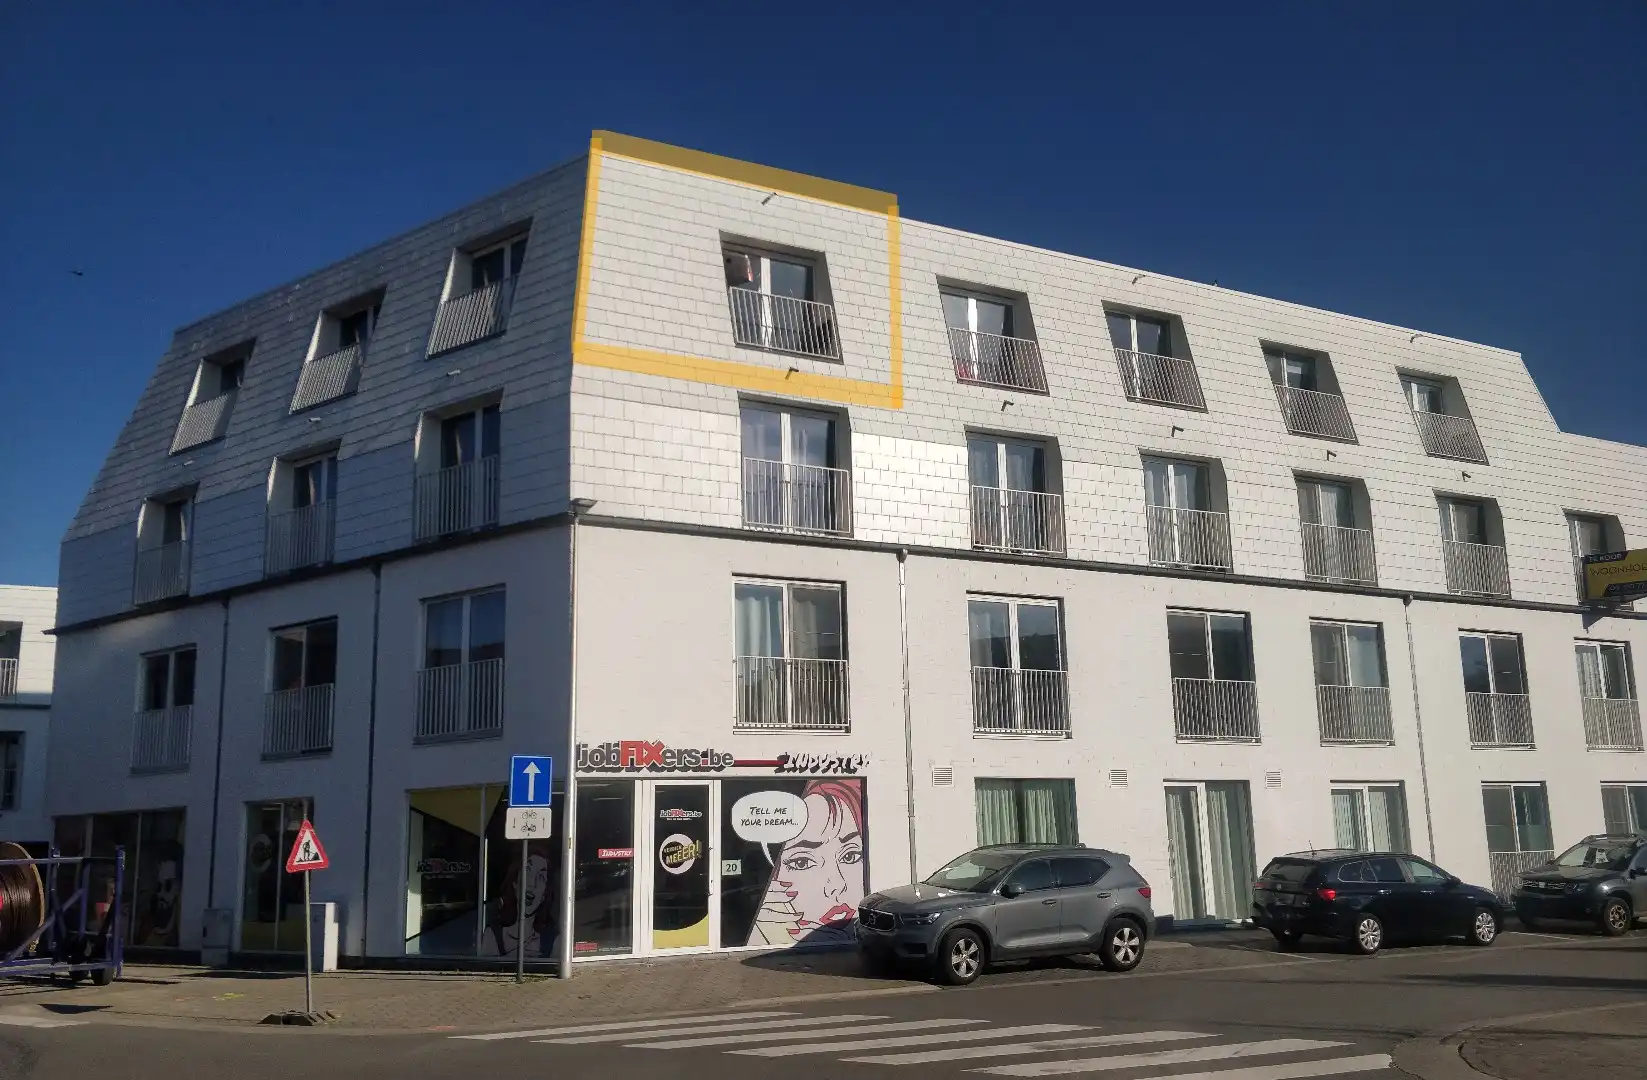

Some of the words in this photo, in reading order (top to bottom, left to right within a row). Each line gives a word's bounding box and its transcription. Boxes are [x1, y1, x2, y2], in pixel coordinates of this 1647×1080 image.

[577, 740, 734, 769] jobFIXers.be
[749, 806, 771, 815] TELL
[774, 807, 787, 815] ME
[741, 818, 762, 826] YOUR
[764, 817, 799, 826] DREAM...
[725, 863, 738, 872] 20
